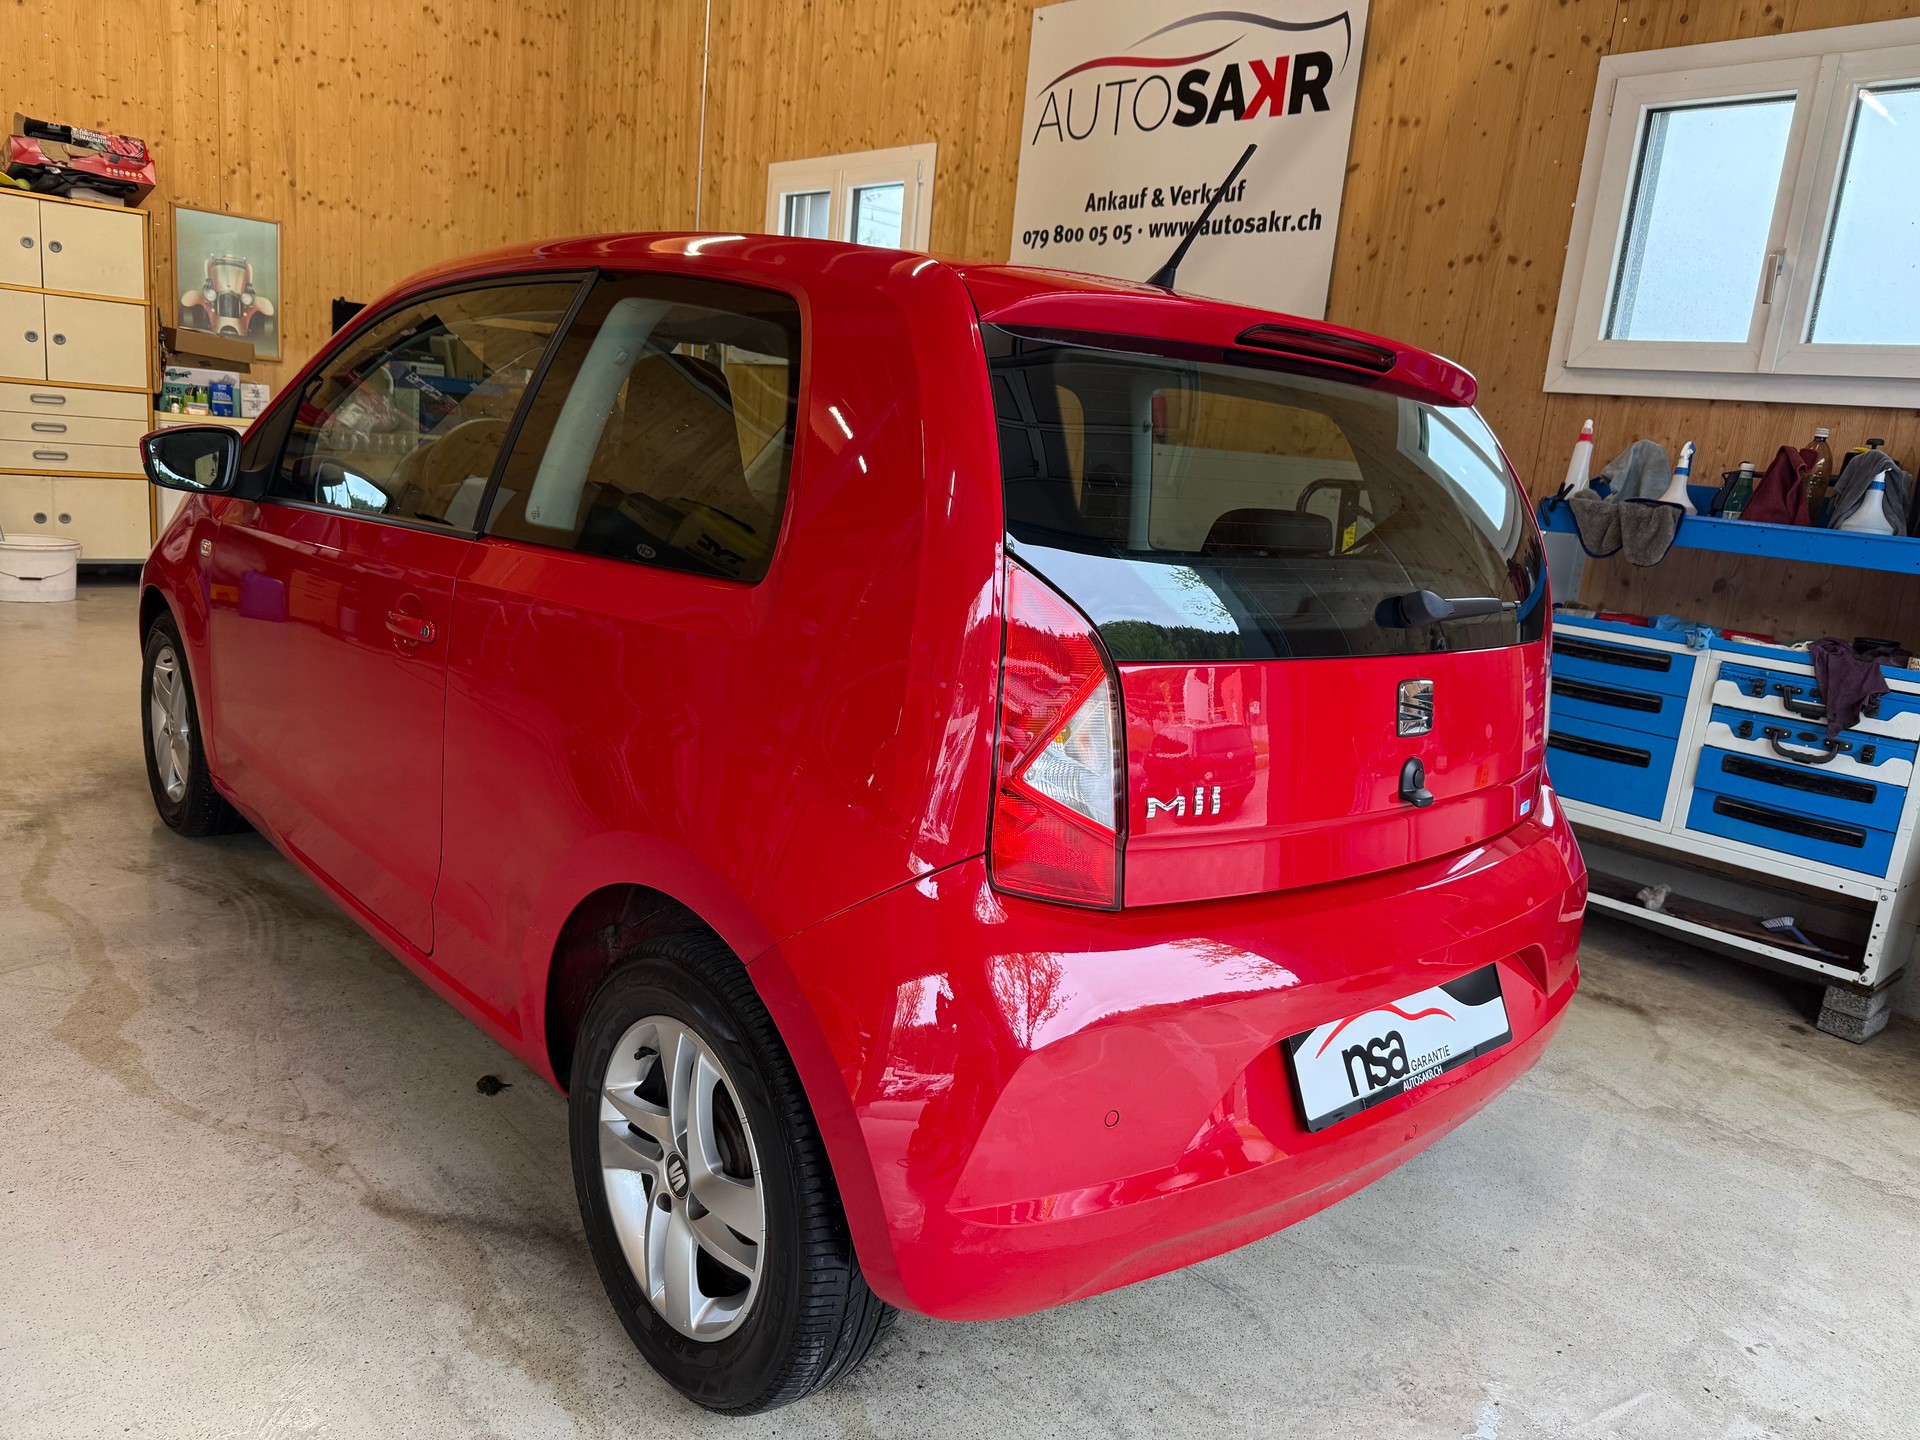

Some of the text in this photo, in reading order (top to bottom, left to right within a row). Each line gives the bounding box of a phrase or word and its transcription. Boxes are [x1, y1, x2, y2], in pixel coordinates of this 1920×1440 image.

[1032, 50, 1334, 146] AUTOSAKR
[1084, 186, 1148, 213] Ankauf
[1151, 187, 1165, 208] &
[1022, 207, 1322, 250] 079 800 05 05 wwwautosakr.ch
[1341, 1030, 1451, 1098] nsa GARANTIE
[1403, 1064, 1444, 1092] AUTOSAKR.CH
